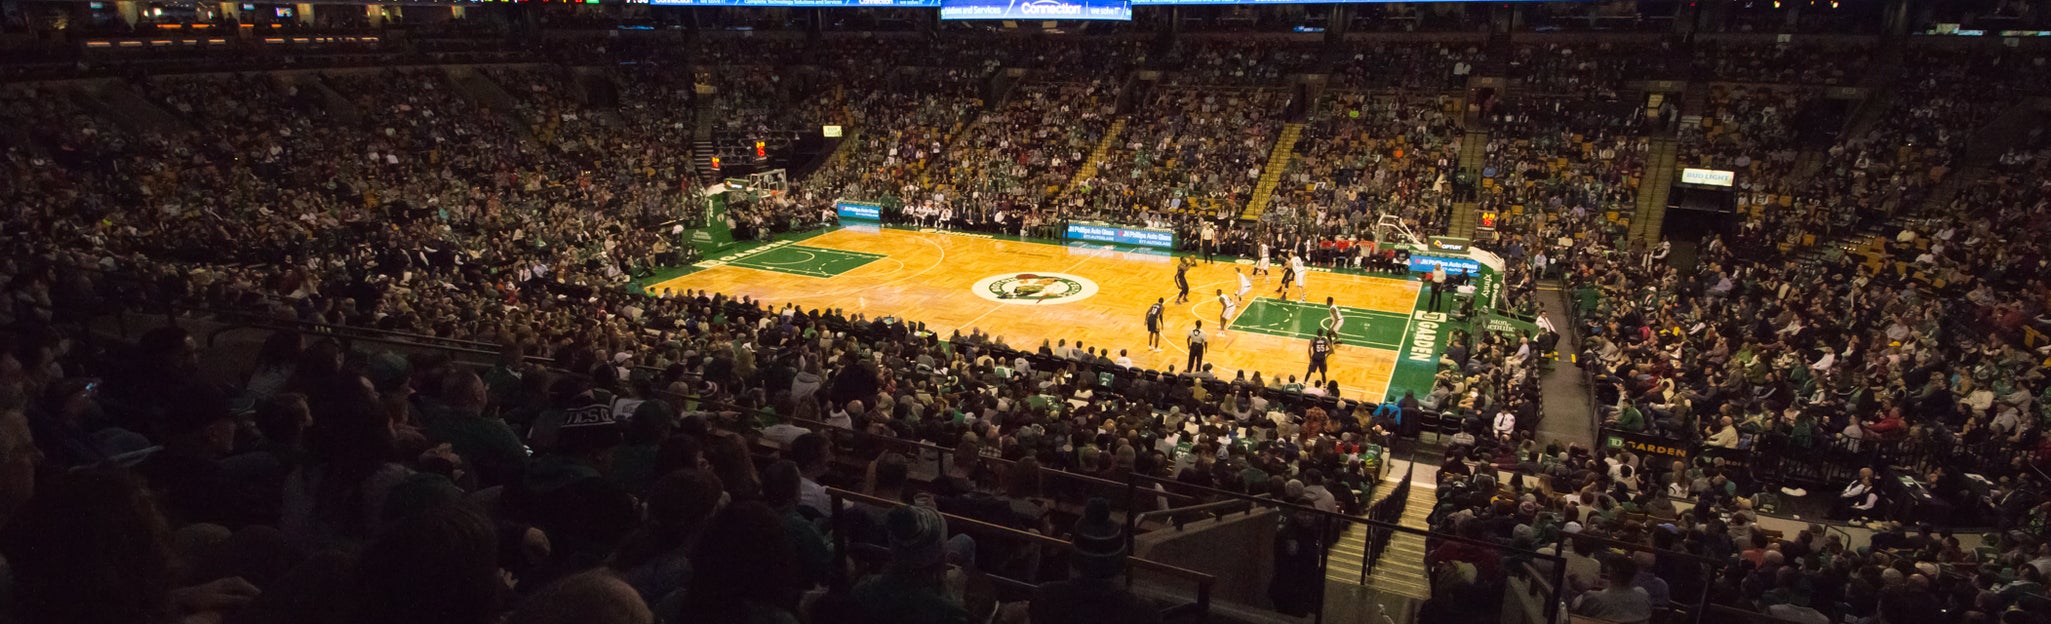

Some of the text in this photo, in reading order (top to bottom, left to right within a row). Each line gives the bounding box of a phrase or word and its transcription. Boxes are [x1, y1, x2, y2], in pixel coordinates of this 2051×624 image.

[974, 6, 1001, 14] Services
[1021, 3, 1081, 15] Connection
[1409, 321, 1440, 362] GARDEN
[1316, 344, 1325, 352] 55
